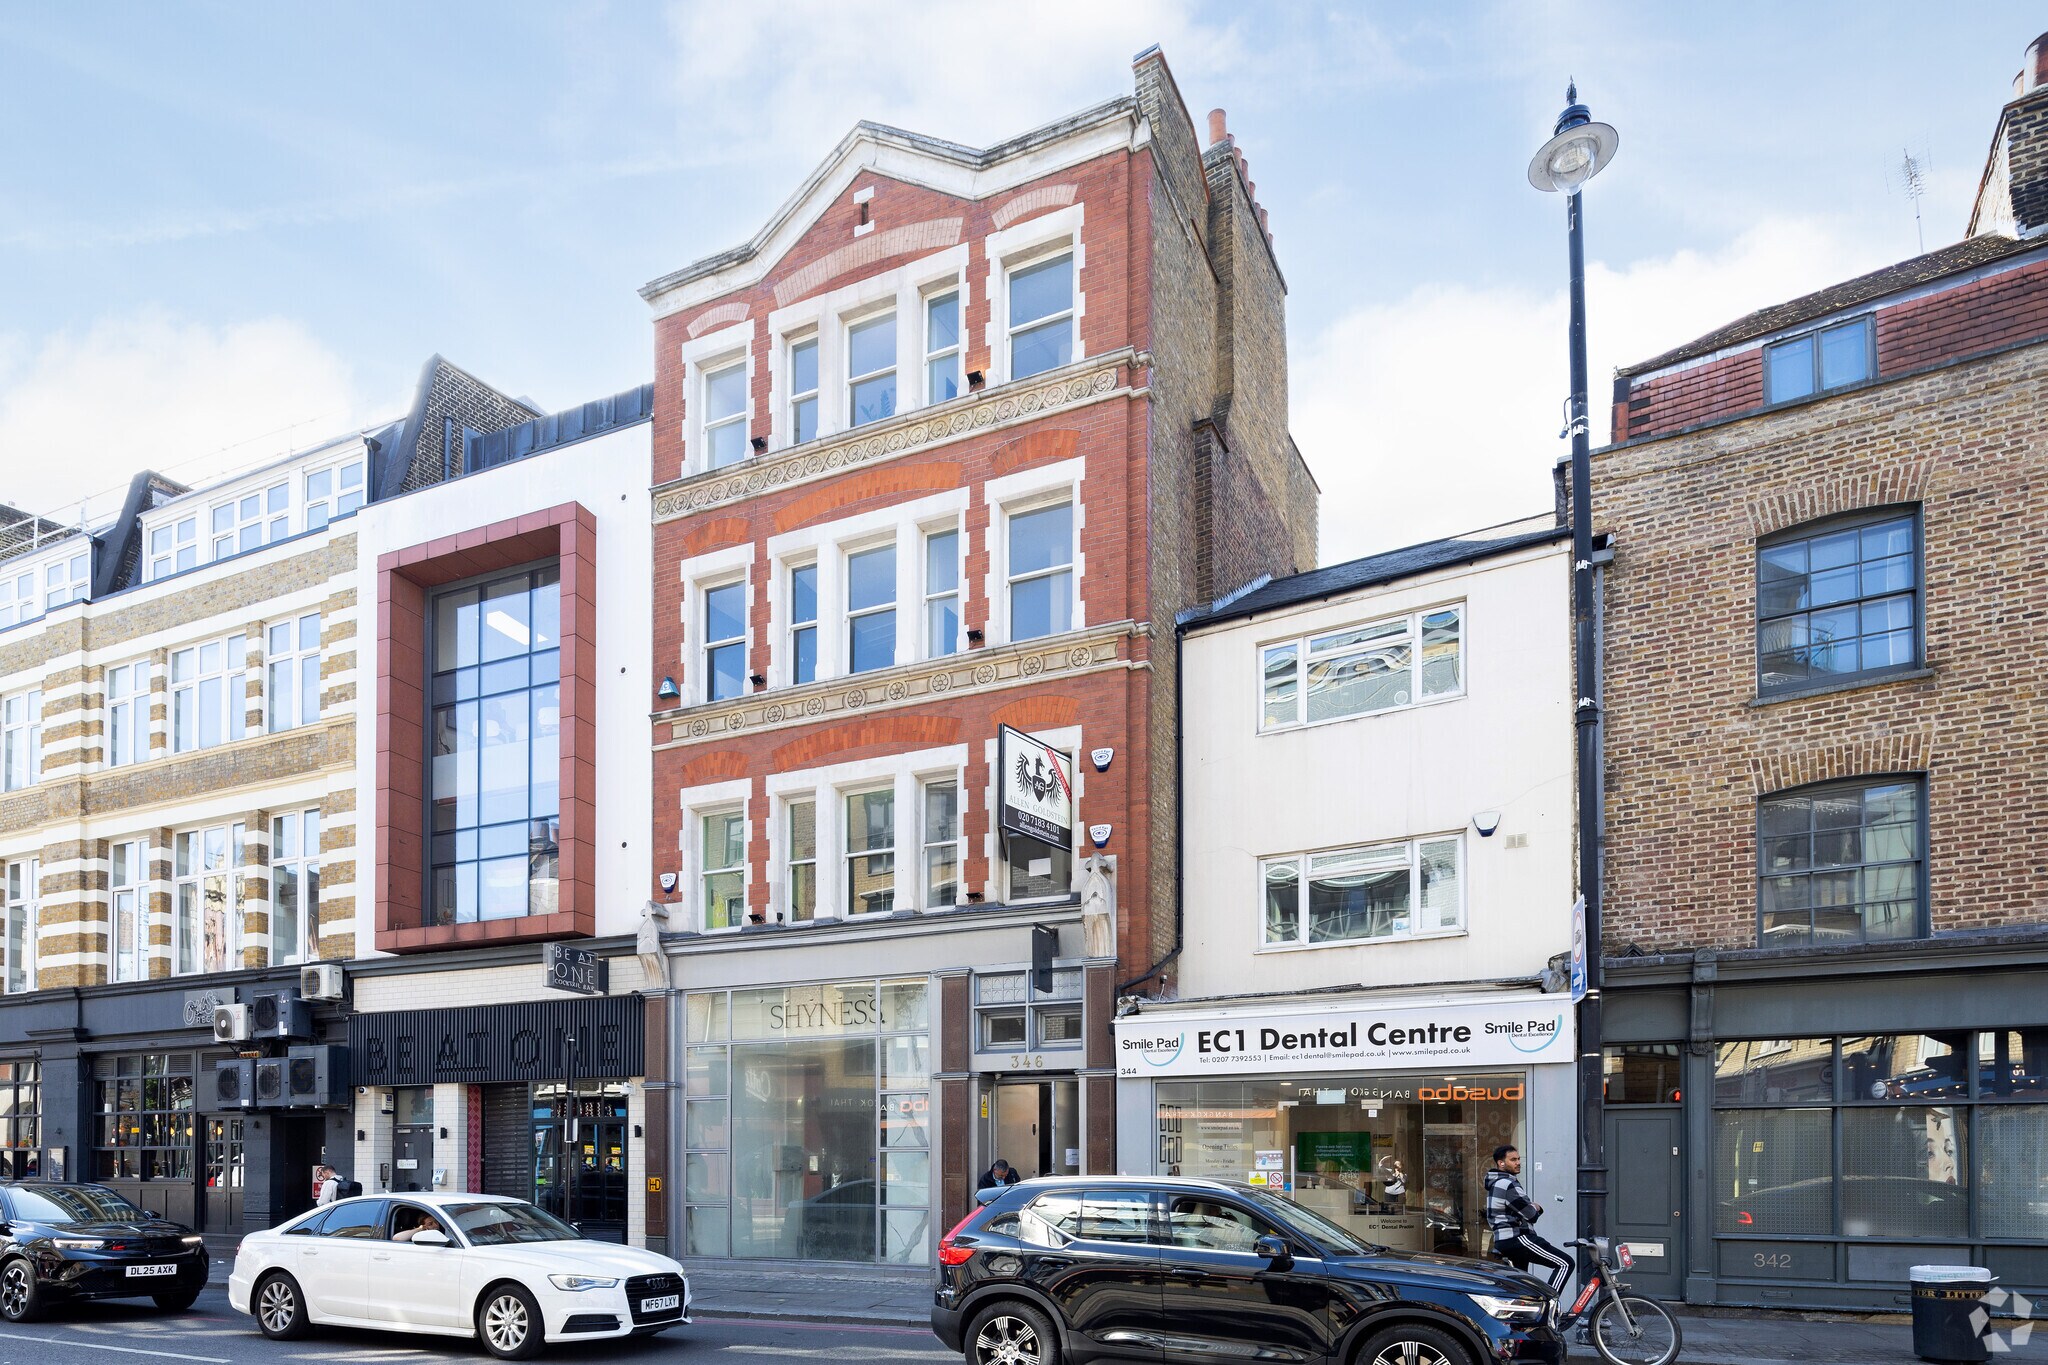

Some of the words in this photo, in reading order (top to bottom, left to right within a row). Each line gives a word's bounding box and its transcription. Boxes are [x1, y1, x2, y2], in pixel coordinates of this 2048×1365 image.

[1009, 795, 1030, 809] ALLEN
[1032, 804, 1068, 825] GOLDSTEIN
[1017, 811, 1030, 822] 020
[1030, 815, 1045, 828] 7183
[1046, 821, 1060, 834] 4101
[1019, 821, 1059, 841] allengoldstein.com
[555, 946, 571, 960] BE
[578, 952, 595, 965] AT
[555, 962, 595, 985] ONE
[555, 978, 581, 989] COCKTAIL
[582, 984, 595, 992] BAR
[1484, 1021, 1523, 1034] Smile
[1527, 1020, 1555, 1032] Pad
[1122, 1038, 1153, 1050] Smile
[1156, 1037, 1179, 1049] Pad
[1198, 1029, 1245, 1053] EC1
[1260, 1022, 1357, 1050] Dental
[1367, 1022, 1472, 1046] Centre
[367, 1035, 414, 1076] BE
[436, 1031, 489, 1073] AT
[512, 1024, 619, 1070] ONE
[1231, 1054, 1262, 1062] 7392553
[1291, 1050, 1386, 1060] ec1dental@smilepad.co.uk
[1392, 1047, 1471, 1056] www.smilepad.co.uk
[1011, 1055, 1043, 1069] 346
[1753, 1253, 1792, 1268] 342
[131, 1267, 154, 1275] DL25
[157, 1266, 173, 1274] AXK
[645, 1299, 663, 1310] MF67
[664, 1296, 677, 1307] LXY
